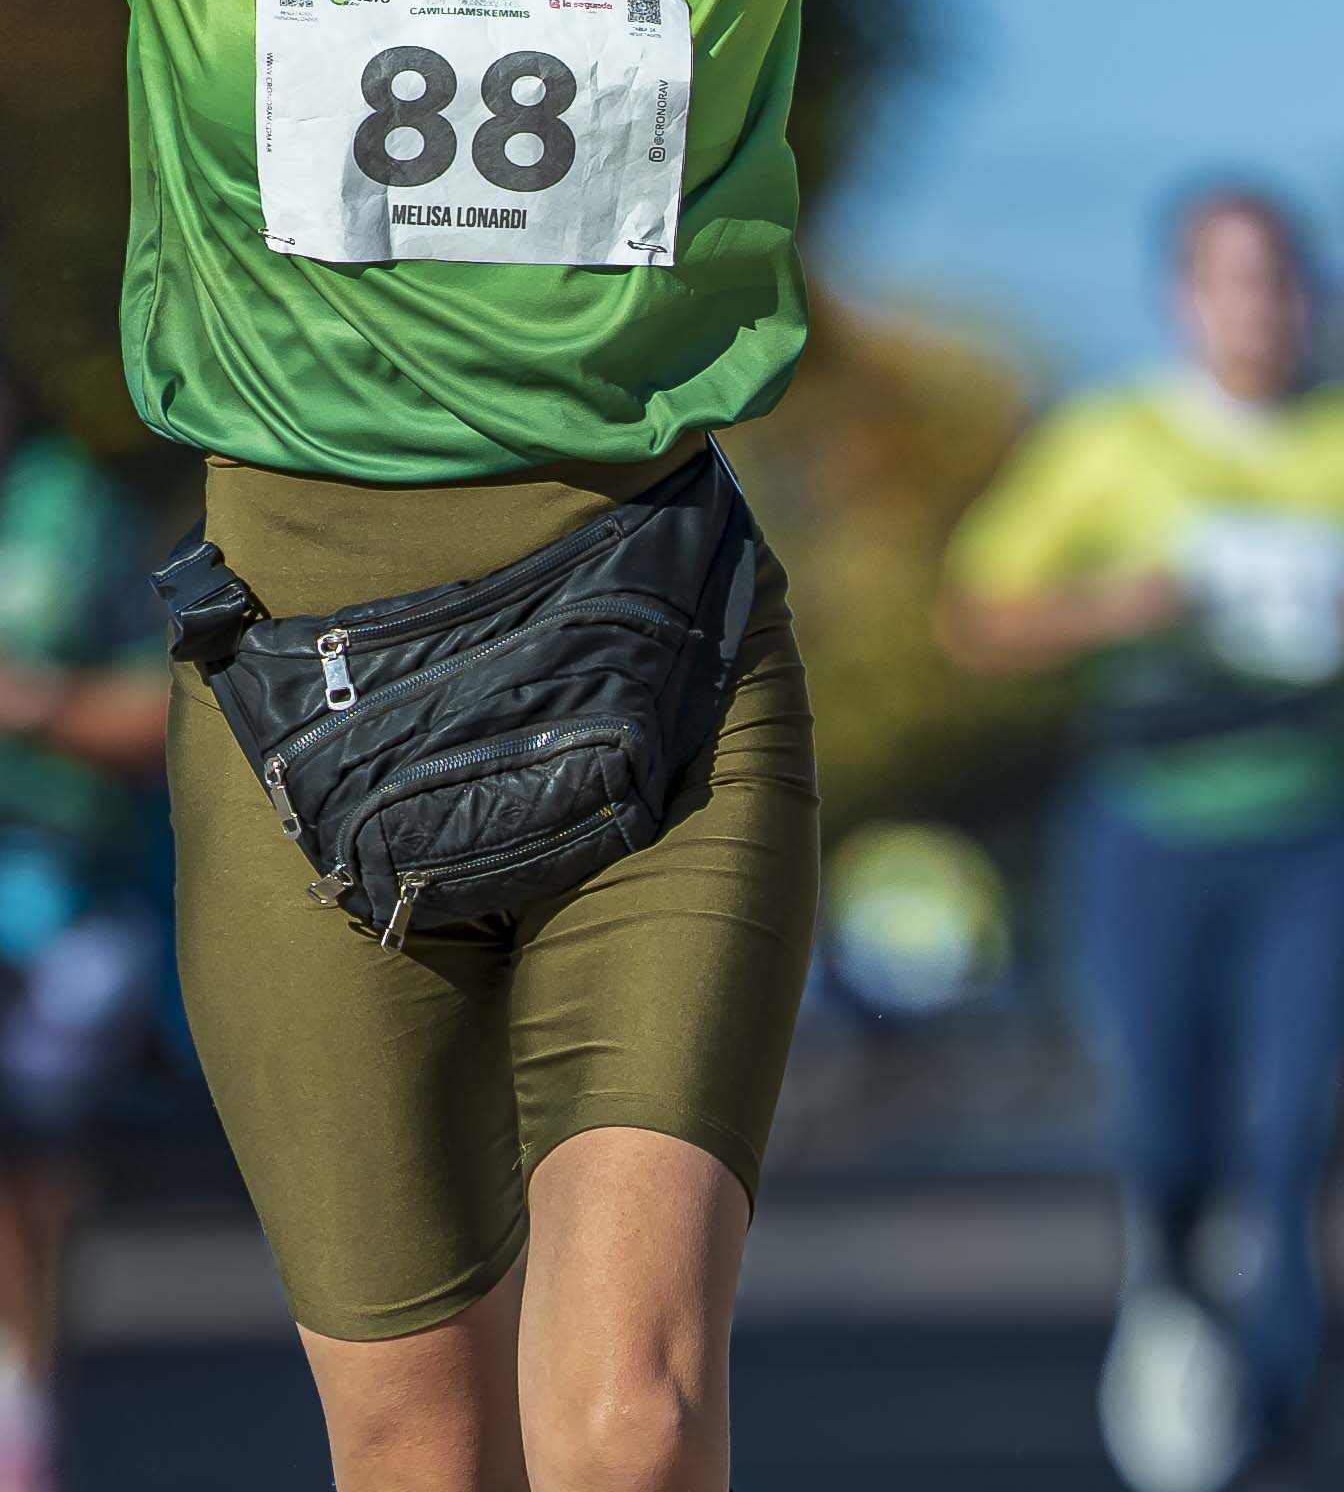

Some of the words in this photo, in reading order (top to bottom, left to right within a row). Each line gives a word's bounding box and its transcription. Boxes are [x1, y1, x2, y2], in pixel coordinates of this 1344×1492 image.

[409, 7, 530, 19] CAWILLIAMSKEMMIS
[353, 45, 577, 192] 88
[654, 79, 669, 146] @CRONORAV
[392, 204, 452, 227] MELISA
[456, 206, 528, 230] LONARDI
